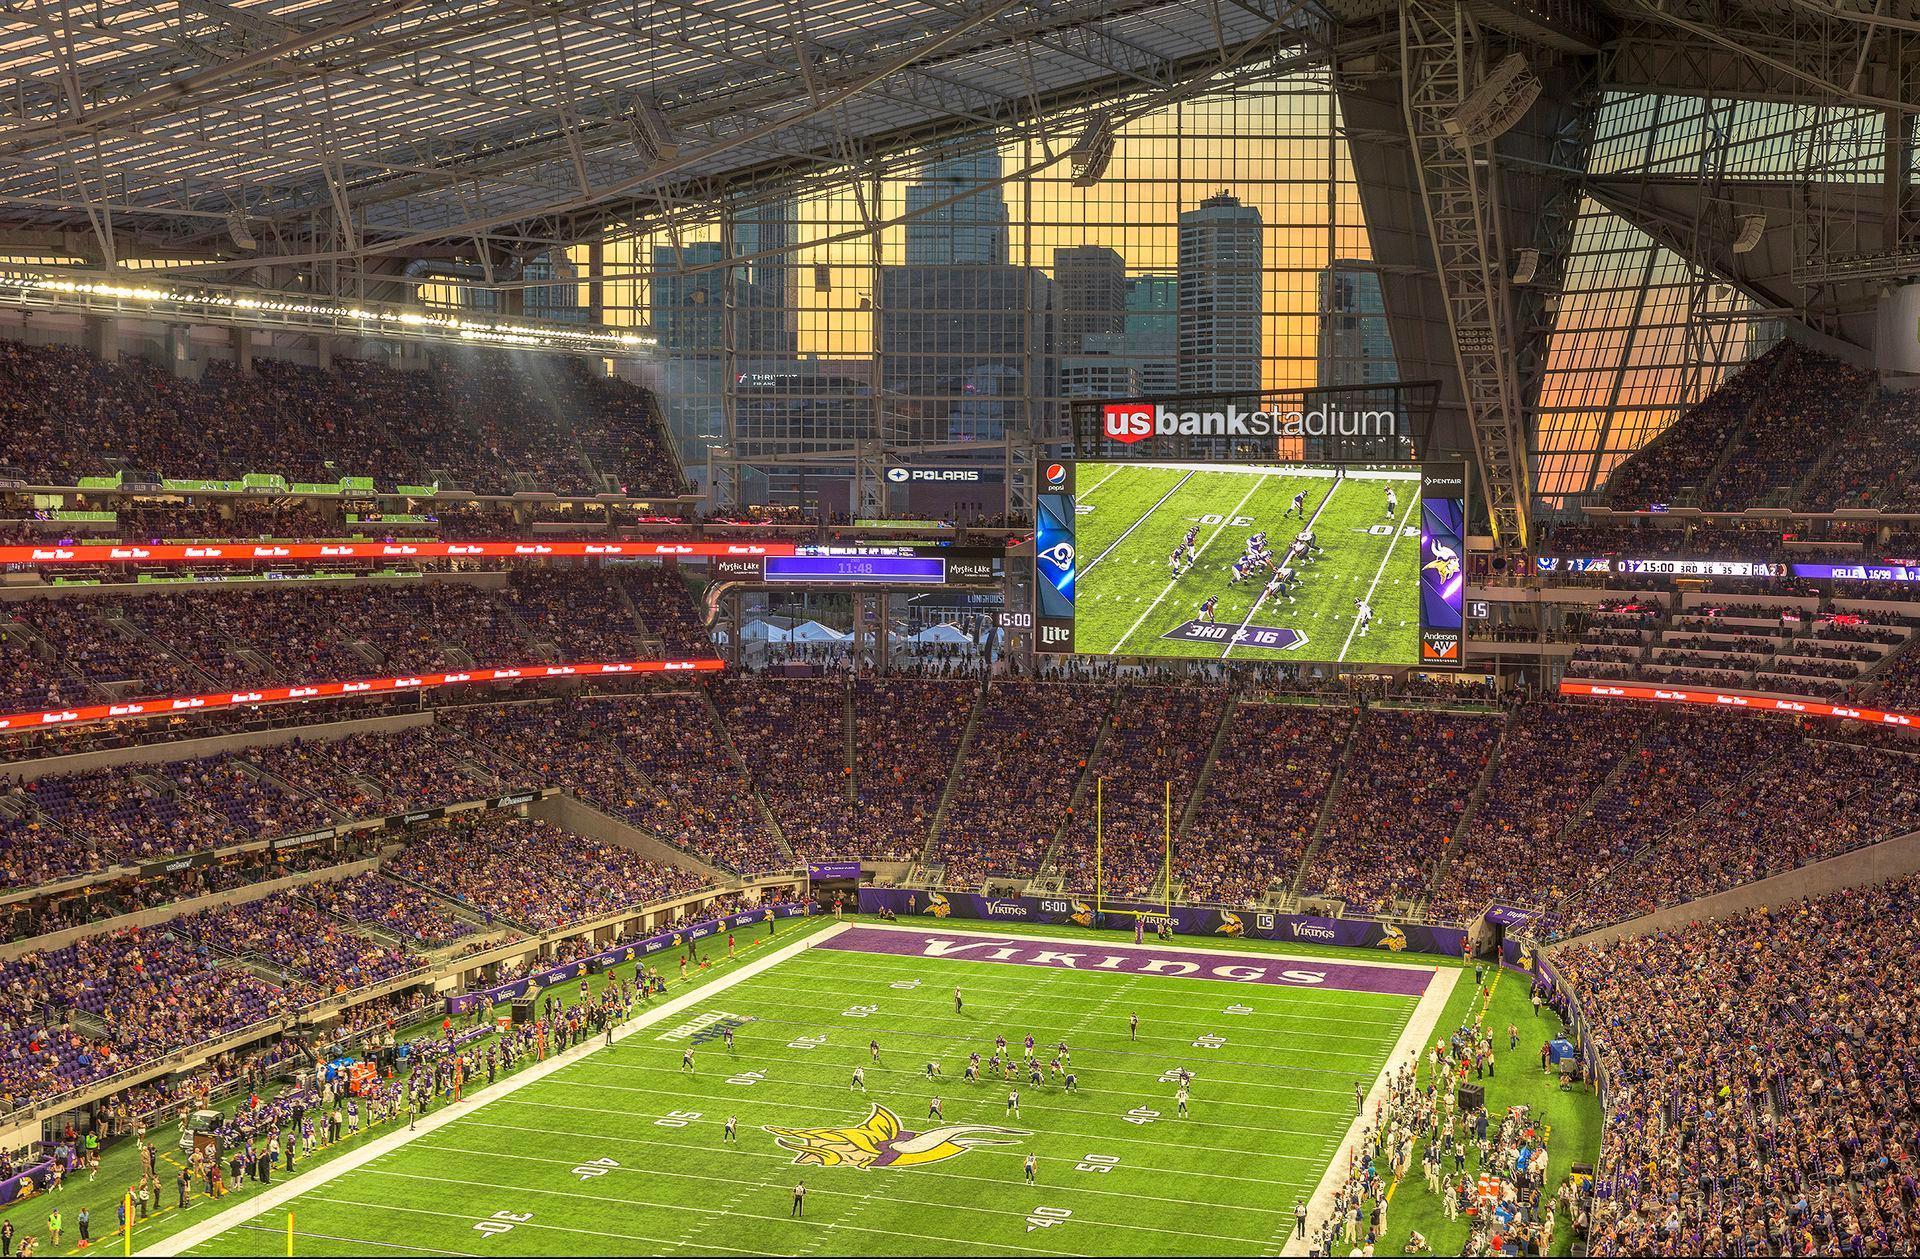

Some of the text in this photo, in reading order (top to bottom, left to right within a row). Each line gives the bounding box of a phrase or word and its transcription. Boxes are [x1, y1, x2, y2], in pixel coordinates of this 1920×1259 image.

[912, 469, 979, 482] POLARIS
[838, 562, 873, 574] 11:48
[1567, 560, 1575, 571] 7
[1618, 561, 1626, 572] 0
[1643, 562, 1674, 572] 15:00
[1681, 565, 1698, 573] 3RD
[1704, 566, 1713, 574] 16
[1473, 603, 1487, 617] 15
[999, 613, 1031, 627] 15:00
[1041, 626, 1070, 644] Lite
[1186, 625, 1227, 639] 3RD
[1253, 631, 1279, 644] 16
[1424, 632, 1458, 641] Andersen
[1042, 901, 1067, 912] 15:00
[1262, 916, 1272, 927] 15
[654, 1110, 703, 1128] 50
[1073, 1153, 1121, 1173] 50
[473, 1211, 534, 1234] 30
